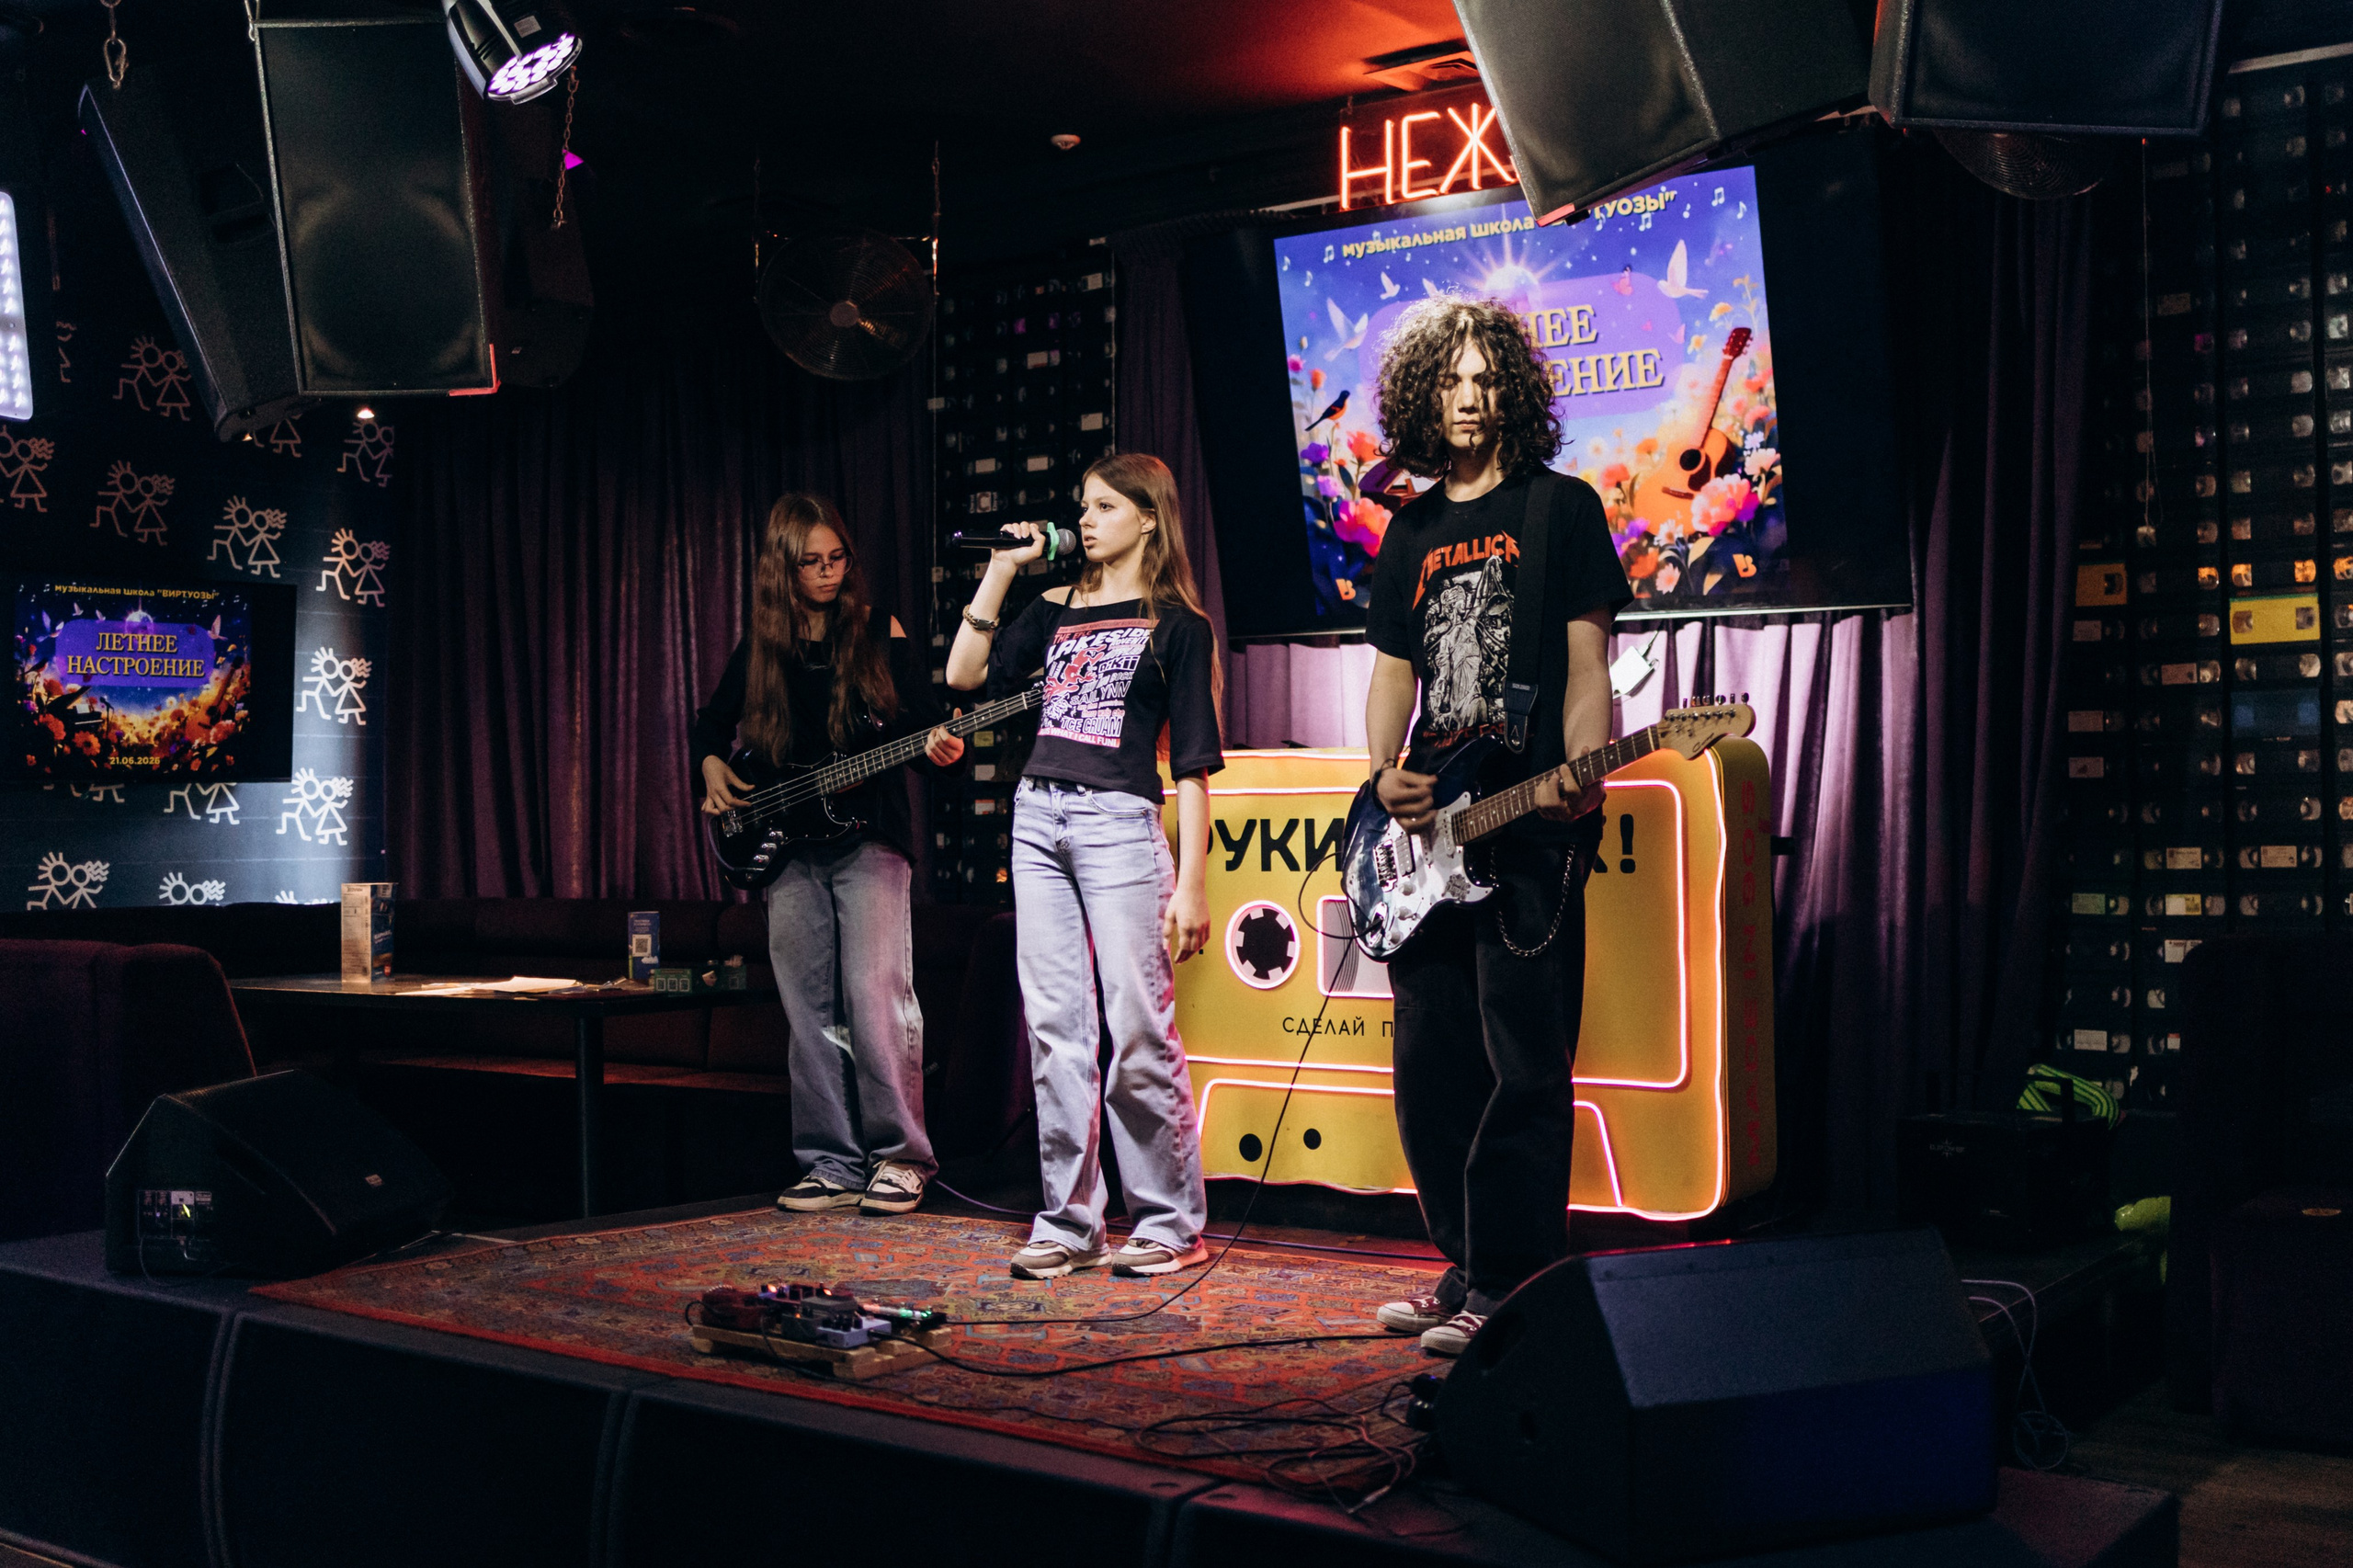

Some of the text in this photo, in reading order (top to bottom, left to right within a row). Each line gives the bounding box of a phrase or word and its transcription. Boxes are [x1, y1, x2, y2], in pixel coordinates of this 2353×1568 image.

[1339, 103, 1519, 212] НЕЖ
[1342, 226, 1467, 259] музыкальная
[1470, 216, 1535, 238] школа
[1412, 529, 1521, 611] METALLICA
[54, 585, 220, 600] музыкальная школа "ВИРТУОЗЫ"
[96, 632, 177, 653] ЛЕТНЕЕ
[1052, 632, 1070, 644] THE
[66, 655, 205, 676] НАСТРОЕНИЕ
[1077, 734, 1097, 744] CALL
[1177, 818, 1346, 872] УКИ
[1282, 1016, 1365, 1037] СДЕЛАЙ
